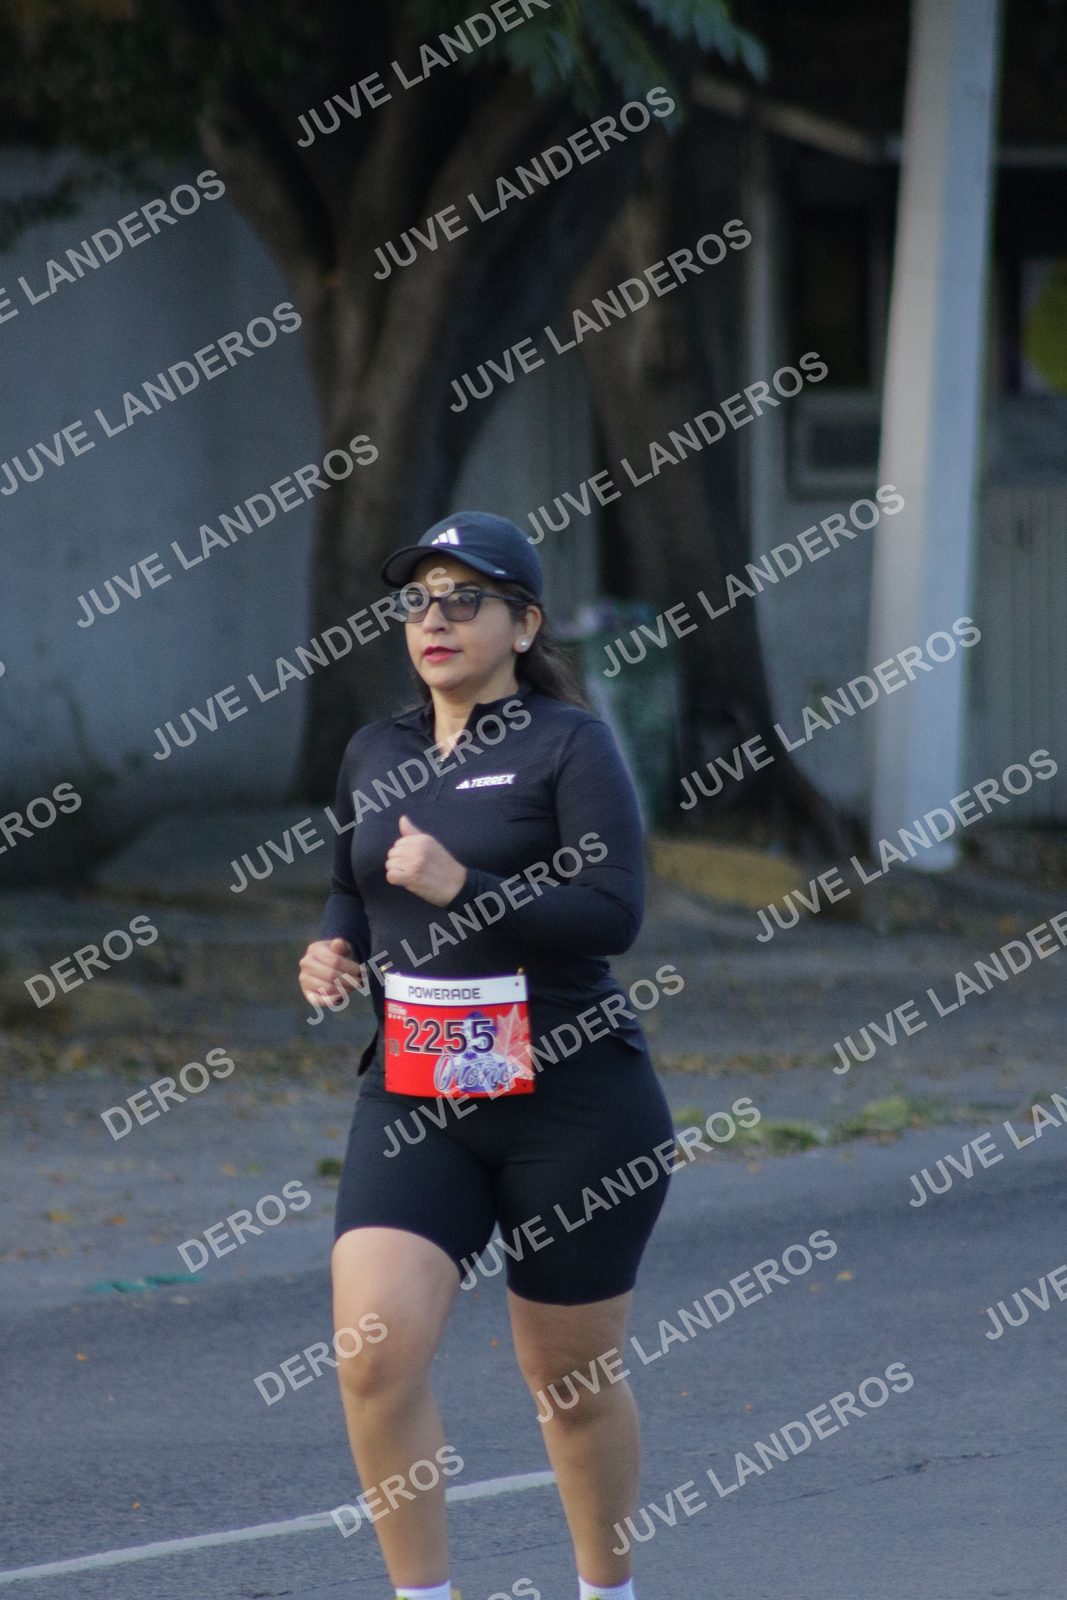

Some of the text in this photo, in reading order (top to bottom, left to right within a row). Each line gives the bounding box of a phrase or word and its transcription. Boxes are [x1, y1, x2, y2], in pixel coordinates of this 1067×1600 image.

[470, 774, 516, 788] TERREX
[408, 985, 481, 1000] POWERADE
[403, 1017, 495, 1055] 2255
